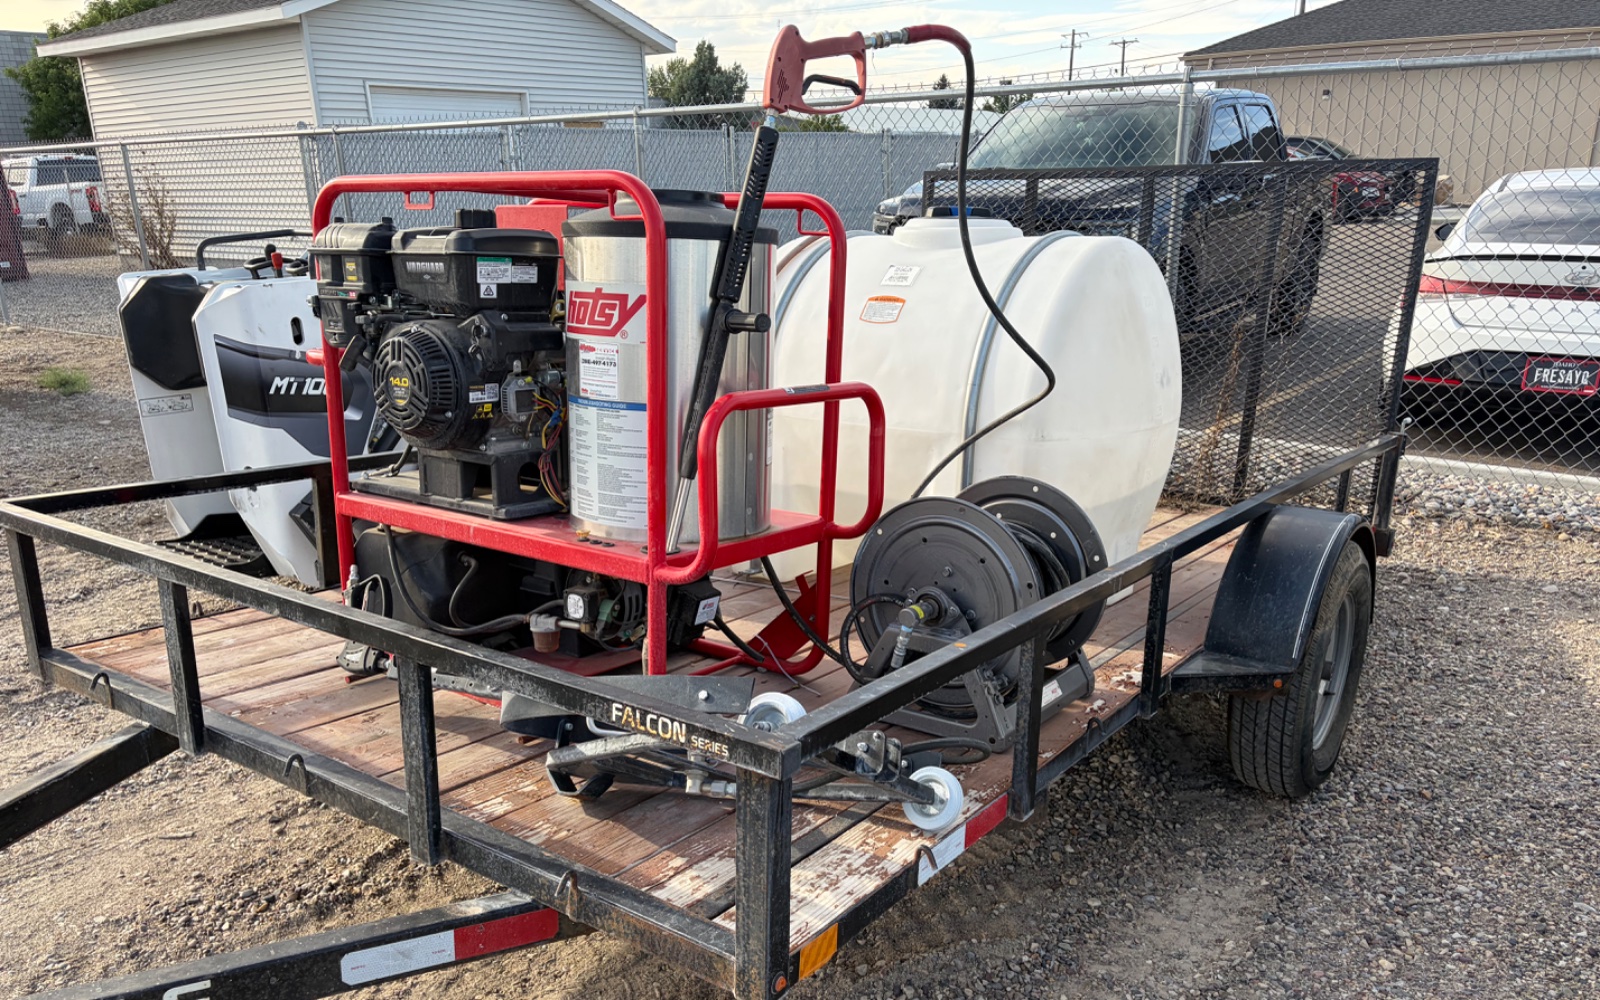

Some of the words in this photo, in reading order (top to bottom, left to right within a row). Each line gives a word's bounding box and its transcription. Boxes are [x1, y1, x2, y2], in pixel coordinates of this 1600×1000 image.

[406, 261, 445, 273] VANGUARD
[567, 287, 647, 337] hotsy
[269, 376, 327, 395] MT10
[390, 377, 408, 386] 14.0
[611, 702, 687, 743] FALCON
[691, 735, 729, 757] SERIES
